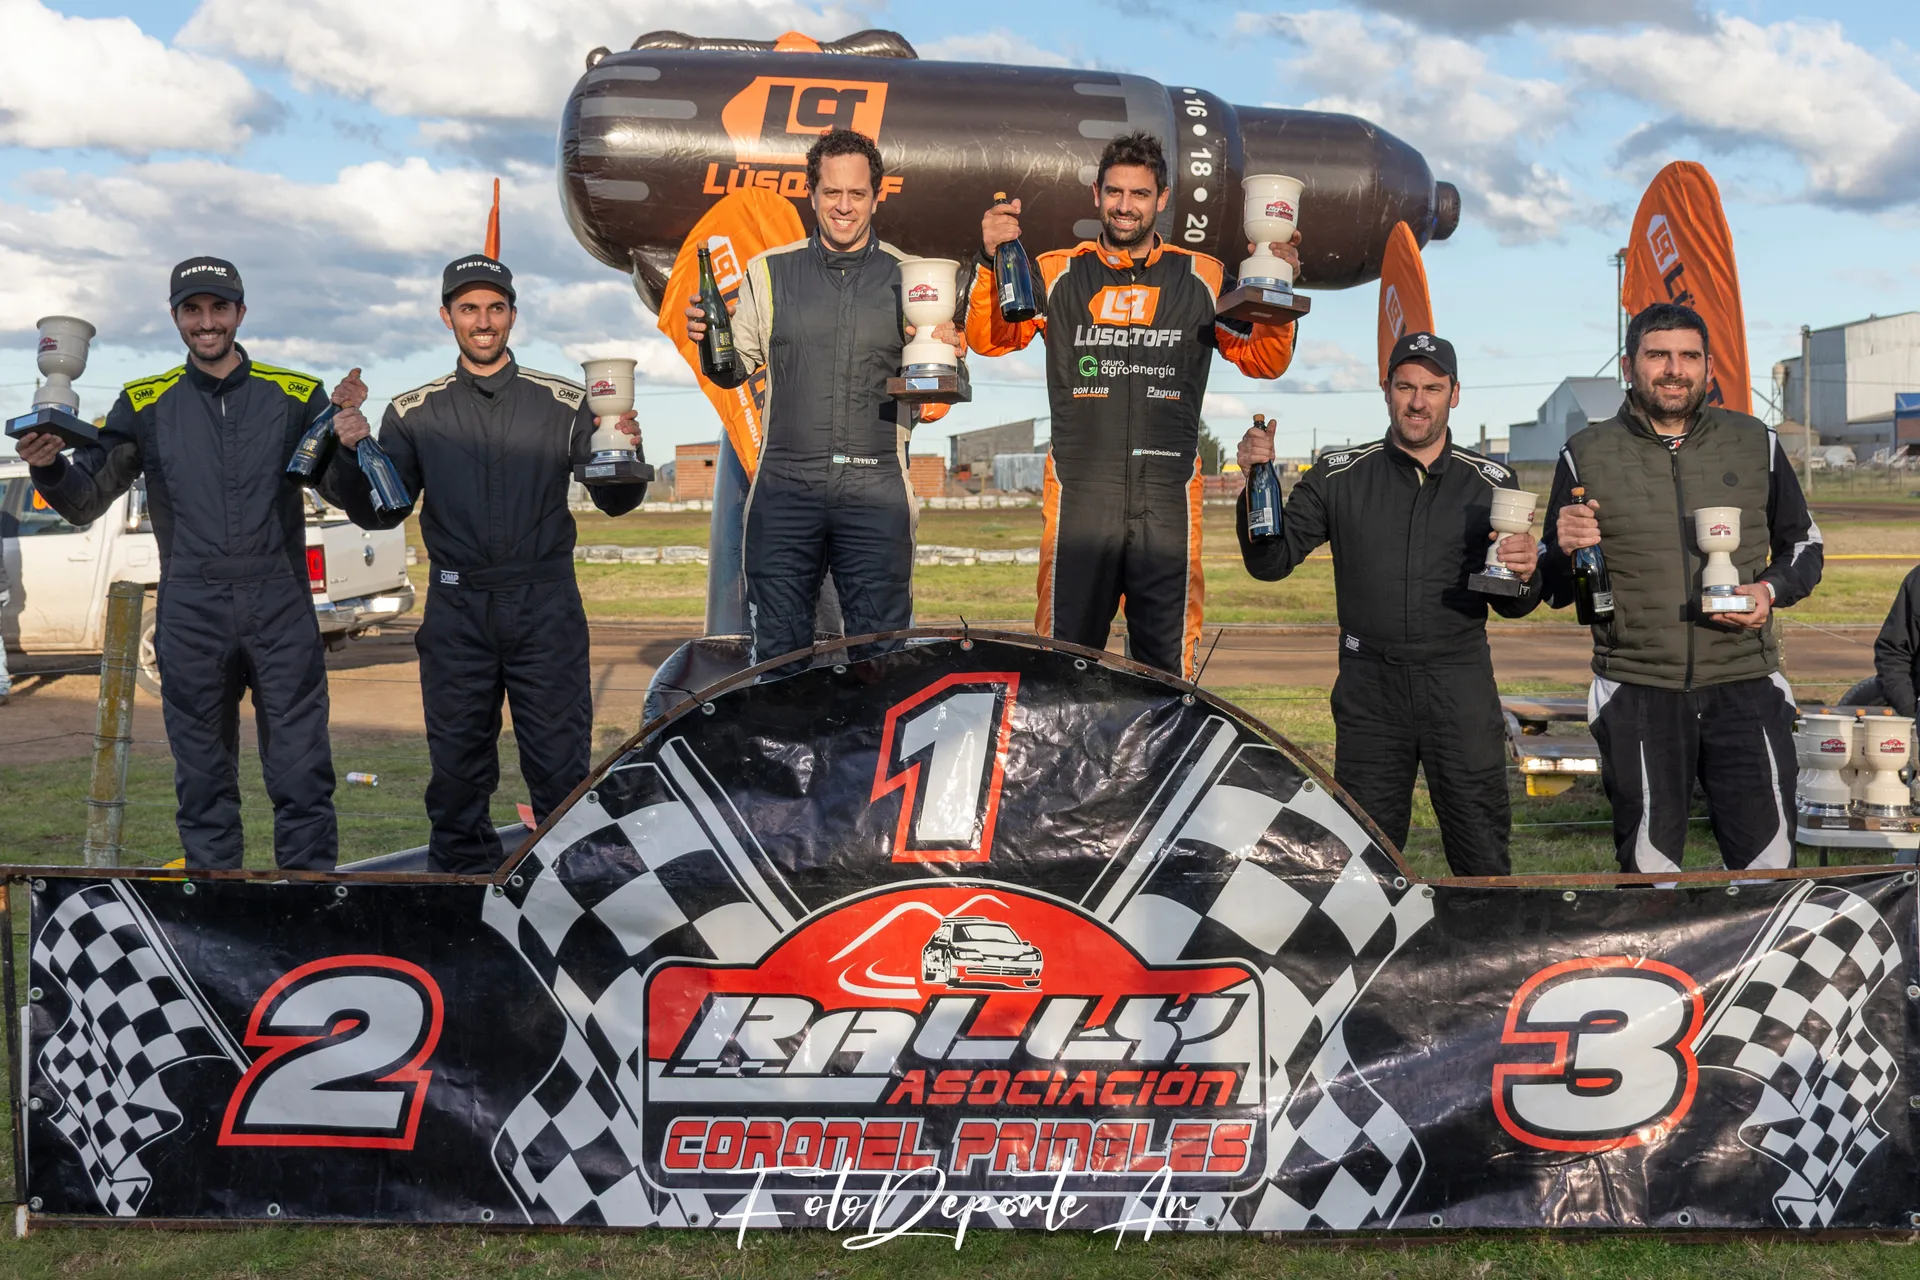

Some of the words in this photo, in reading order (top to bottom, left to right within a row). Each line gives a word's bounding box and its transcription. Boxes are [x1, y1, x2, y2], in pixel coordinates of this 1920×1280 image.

[1184, 98, 1208, 118] 16
[1190, 147, 1213, 177] 18
[702, 162, 904, 203] LÜSQF
[1183, 213, 1209, 243] 20
[1073, 325, 1182, 348] LÜSQTOFF
[1101, 364, 1176, 379] agroenergía
[133, 389, 156, 401] OMP
[288, 384, 309, 394] OMP
[558, 389, 580, 400] OMP
[1072, 387, 1088, 395] DON
[1089, 386, 1109, 395] LUIS
[400, 394, 421, 406] OMP
[1328, 454, 1350, 465] OMP
[1483, 464, 1505, 479] OMP
[440, 572, 460, 583] OMP
[886, 682, 1010, 853] 1
[675, 993, 1239, 1075] RALLY
[231, 965, 435, 1140] 2
[1502, 967, 1695, 1142] 3
[885, 1064, 1238, 1107] ASOCIACIÓN
[660, 1116, 942, 1176] CORONEL
[948, 1117, 1258, 1178] PRINGLES
